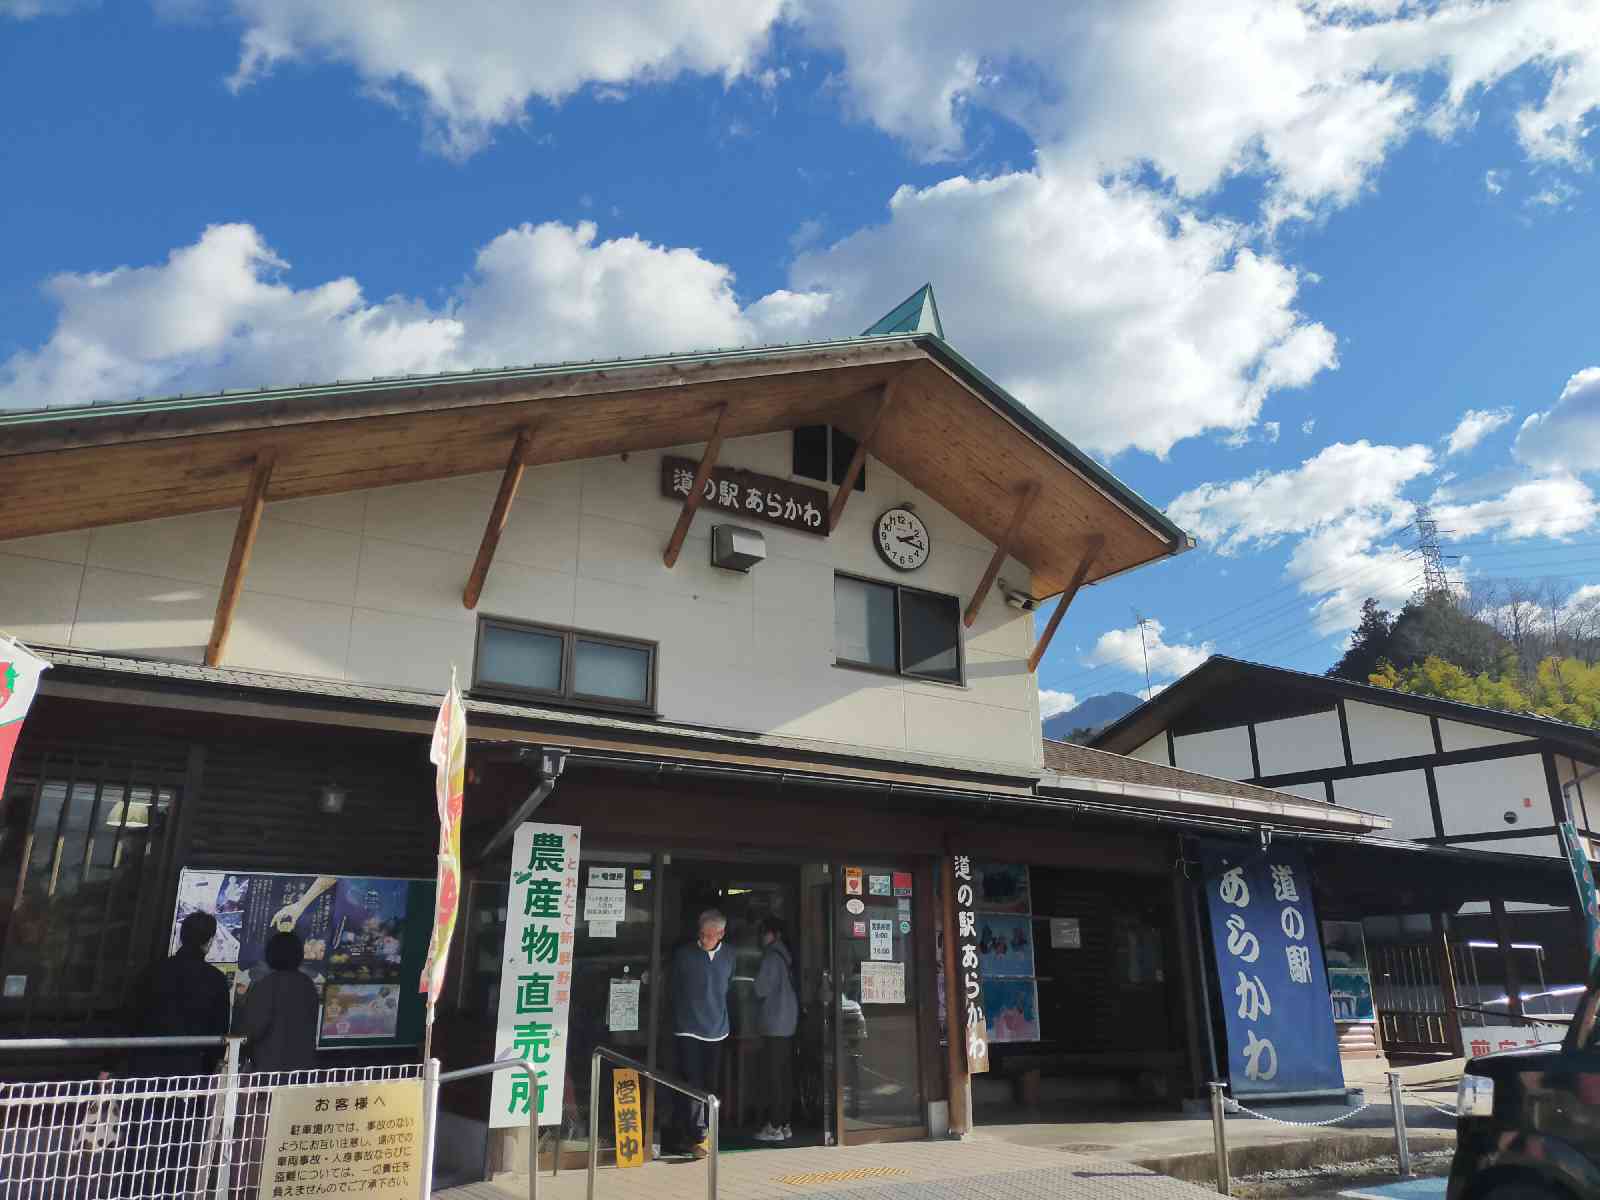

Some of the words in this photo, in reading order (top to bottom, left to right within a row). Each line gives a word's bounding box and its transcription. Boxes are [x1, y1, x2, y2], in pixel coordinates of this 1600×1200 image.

[673, 467, 740, 510] 道の駅
[745, 487, 822, 527] あらかわ
[507, 832, 566, 1115] 農産物直売所
[1219, 858, 1278, 1081] あらかわ
[1270, 864, 1313, 983] 道の駅
[314, 1096, 386, 1112] お客様へ
[616, 1079, 639, 1162] 営業中
